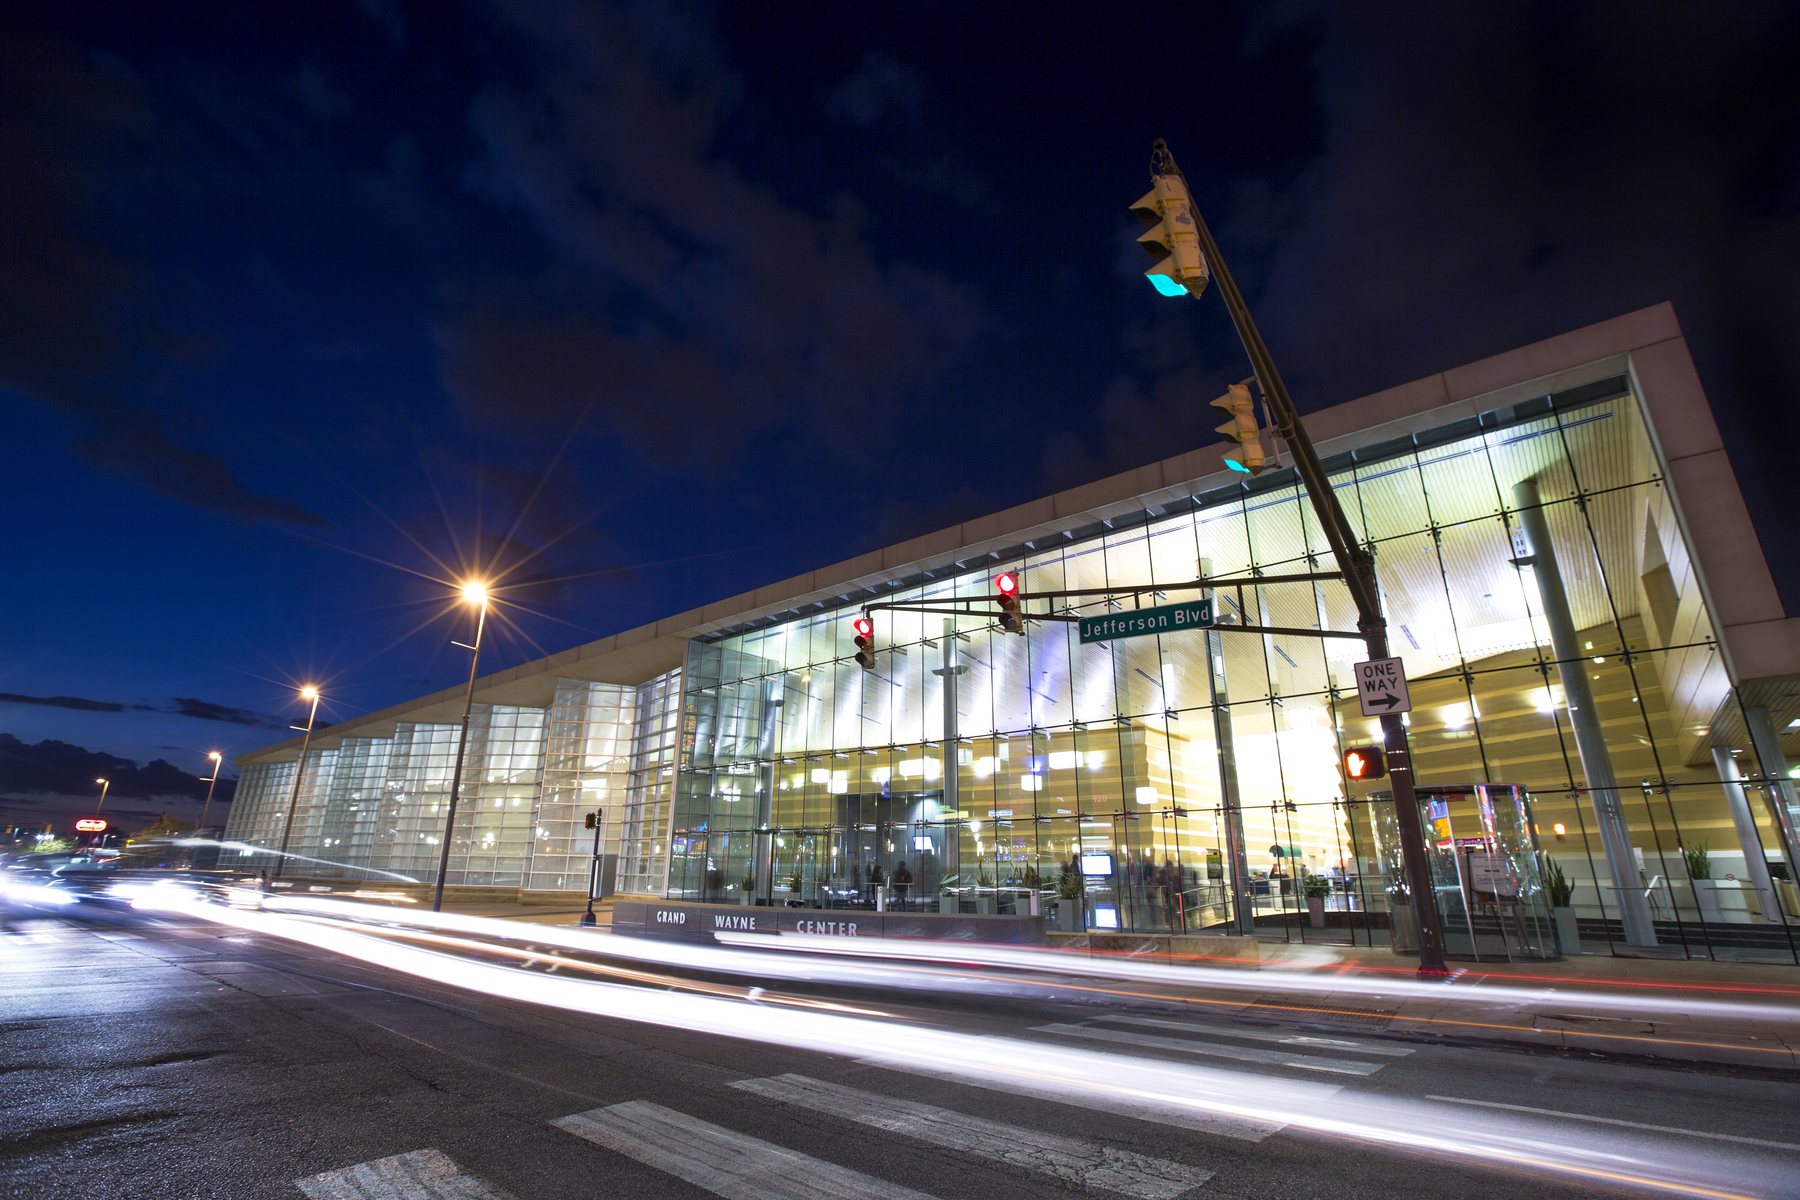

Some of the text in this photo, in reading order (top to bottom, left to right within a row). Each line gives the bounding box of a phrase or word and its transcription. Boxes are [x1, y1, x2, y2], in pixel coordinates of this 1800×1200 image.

[1083, 606, 1209, 638] Jefferson Blvd
[1363, 662, 1396, 678] ONE
[1364, 677, 1398, 693] WAY
[656, 910, 858, 937] GRAND WAYNE CENTER
